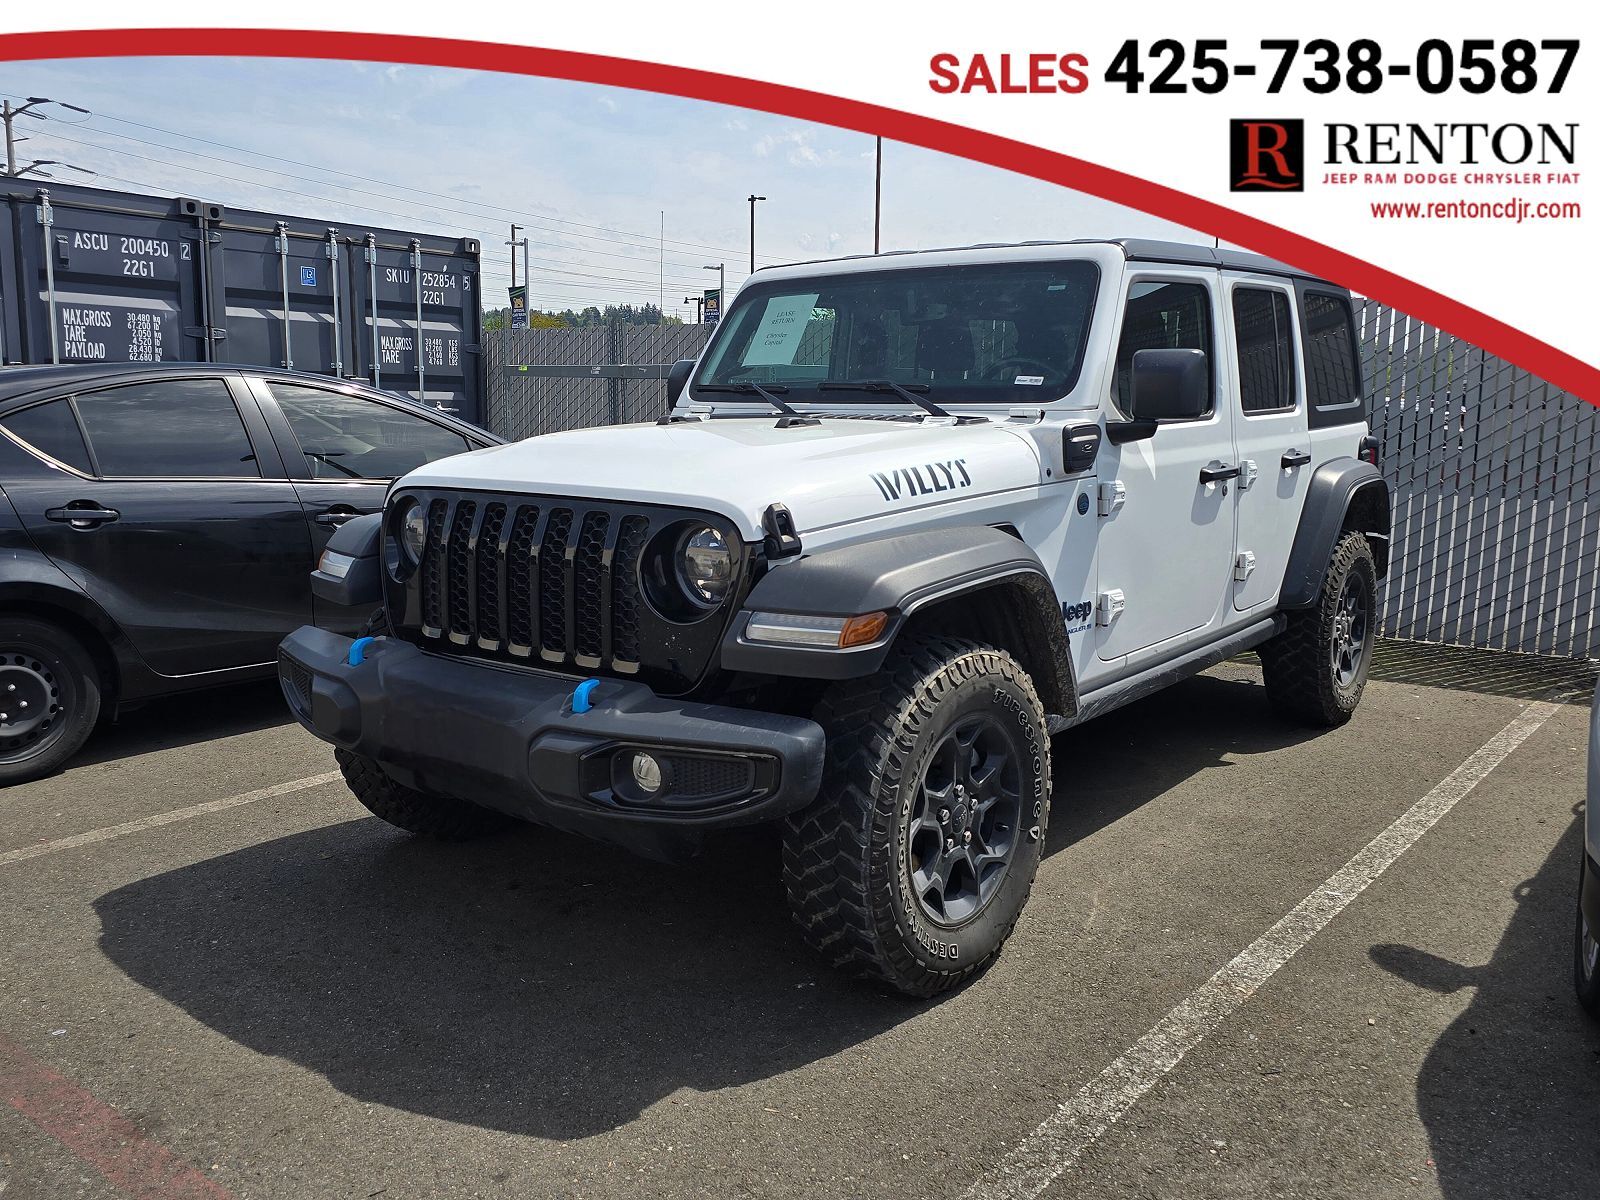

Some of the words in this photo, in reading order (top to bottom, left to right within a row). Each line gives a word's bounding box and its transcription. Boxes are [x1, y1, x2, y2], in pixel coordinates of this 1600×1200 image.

[74, 232, 109, 251] ASCU
[120, 237, 169, 258] 200450
[181, 244, 190, 259] 2
[122, 259, 155, 278] 22G1
[386, 268, 410, 284] SKIU
[422, 272, 456, 289] 252854
[463, 276, 470, 290] 5
[422, 290, 445, 306] 22G1
[62, 308, 112, 328] MAX.GROSS
[126, 312, 150, 322] 30.480
[152, 314, 161, 325] kg
[127, 321, 151, 330] 67.200
[153, 322, 160, 331] lb
[63, 324, 87, 342] TARE
[132, 329, 152, 338] 2.050
[154, 330, 162, 340] kg
[132, 337, 152, 346] 4.520
[154, 338, 161, 346] lb
[64, 340, 106, 359] PAYLOAD
[128, 344, 152, 353] 28.430
[154, 346, 163, 357] kg
[129, 353, 153, 361] 62.680
[381, 350, 401, 364] TARE
[868, 458, 972, 502] WILLYS
[1062, 600, 1092, 622] Jeep
[993, 688, 1043, 819] Firestone
